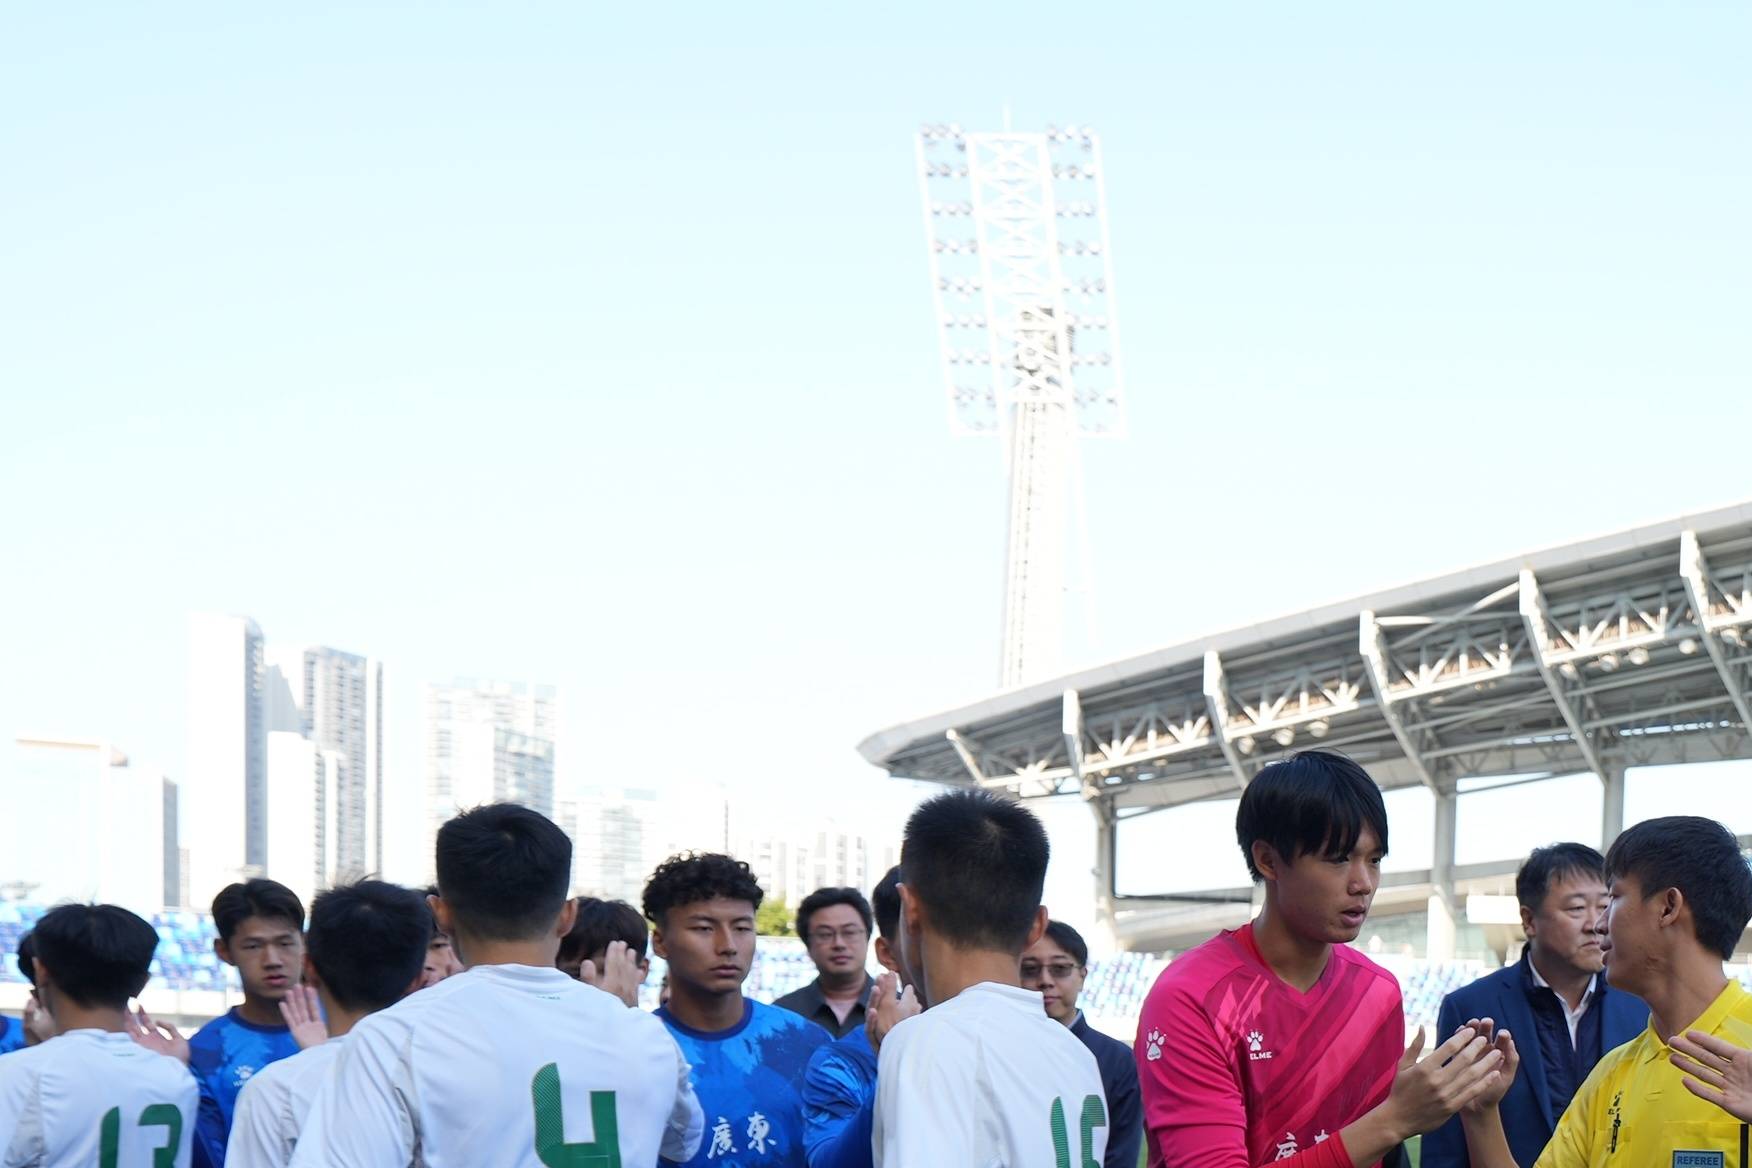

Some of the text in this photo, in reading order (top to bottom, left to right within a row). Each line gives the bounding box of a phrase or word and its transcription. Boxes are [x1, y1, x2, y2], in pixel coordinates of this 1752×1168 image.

[1249, 1051, 1273, 1061] ELME
[707, 1111, 778, 1160] 廣東
[1676, 1155, 1720, 1167] REFEREE
